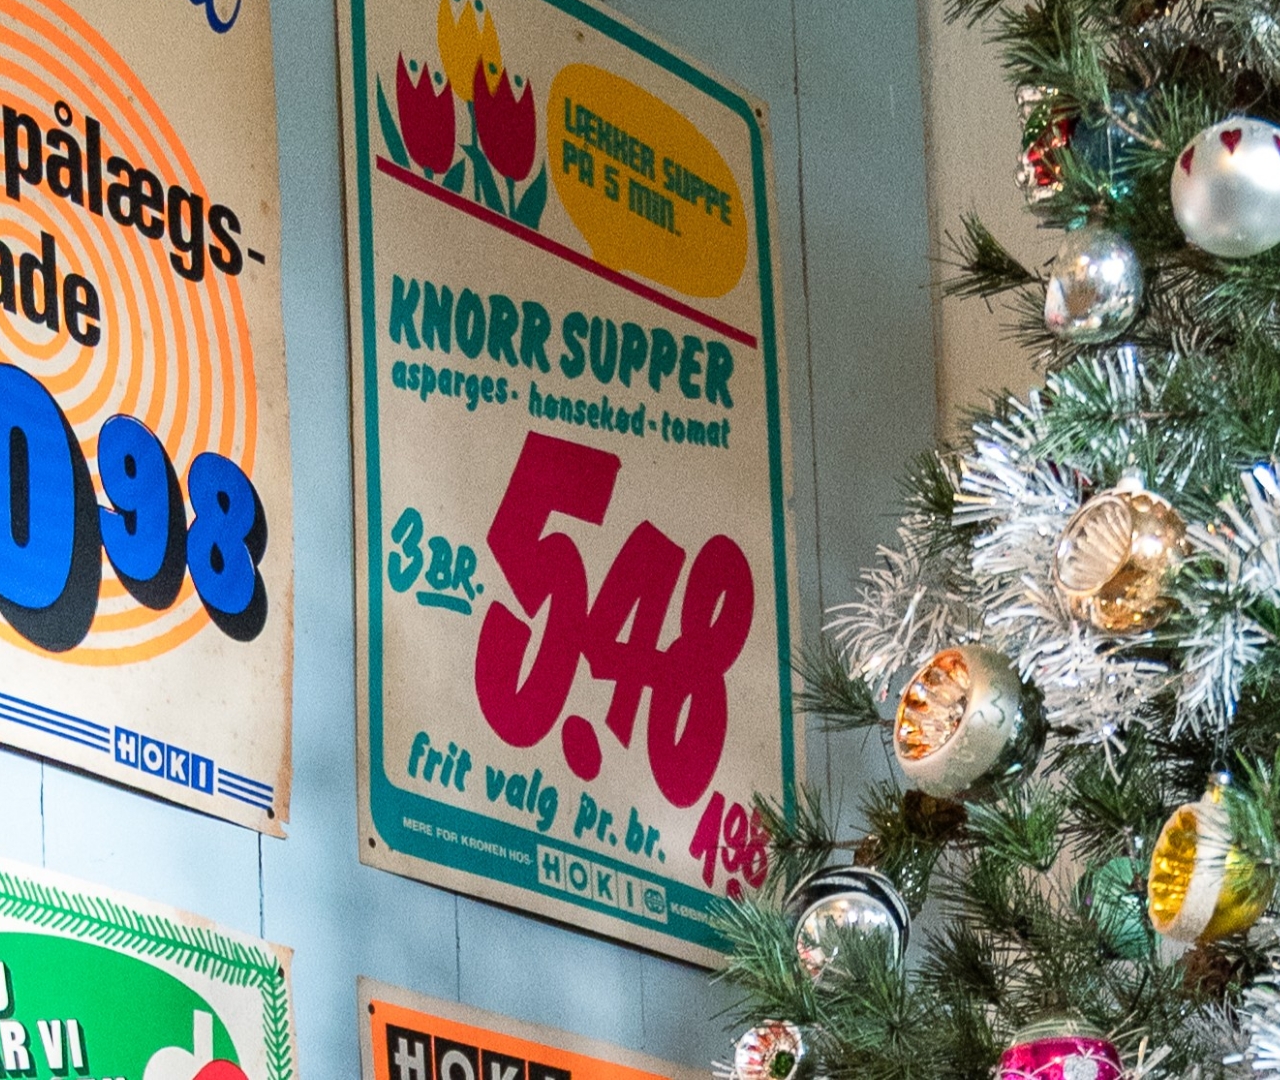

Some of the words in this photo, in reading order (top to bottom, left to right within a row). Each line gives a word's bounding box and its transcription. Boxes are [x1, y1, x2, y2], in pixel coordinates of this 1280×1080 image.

[563, 139, 595, 189] PÅ
[604, 164, 620, 203] 5
[564, 97, 656, 183] LÆKKER
[663, 156, 733, 228] SUPPE
[389, 274, 551, 373] KNORR
[559, 311, 735, 409] SUPPER
[388, 506, 424, 594] 3
[425, 536, 485, 601] BR.
[117, 729, 209, 790] HOKI
[407, 731, 472, 791] frit
[486, 765, 558, 832] valg
[574, 791, 618, 847] pr.
[625, 810, 666, 864] br.
[403, 816, 433, 837] MERE
[436, 827, 459, 844] FOR
[461, 835, 507, 858] KRONEN
[542, 852, 634, 908] HOKI
[37, 1018, 83, 1069] VI
[394, 1036, 556, 1080] HO
